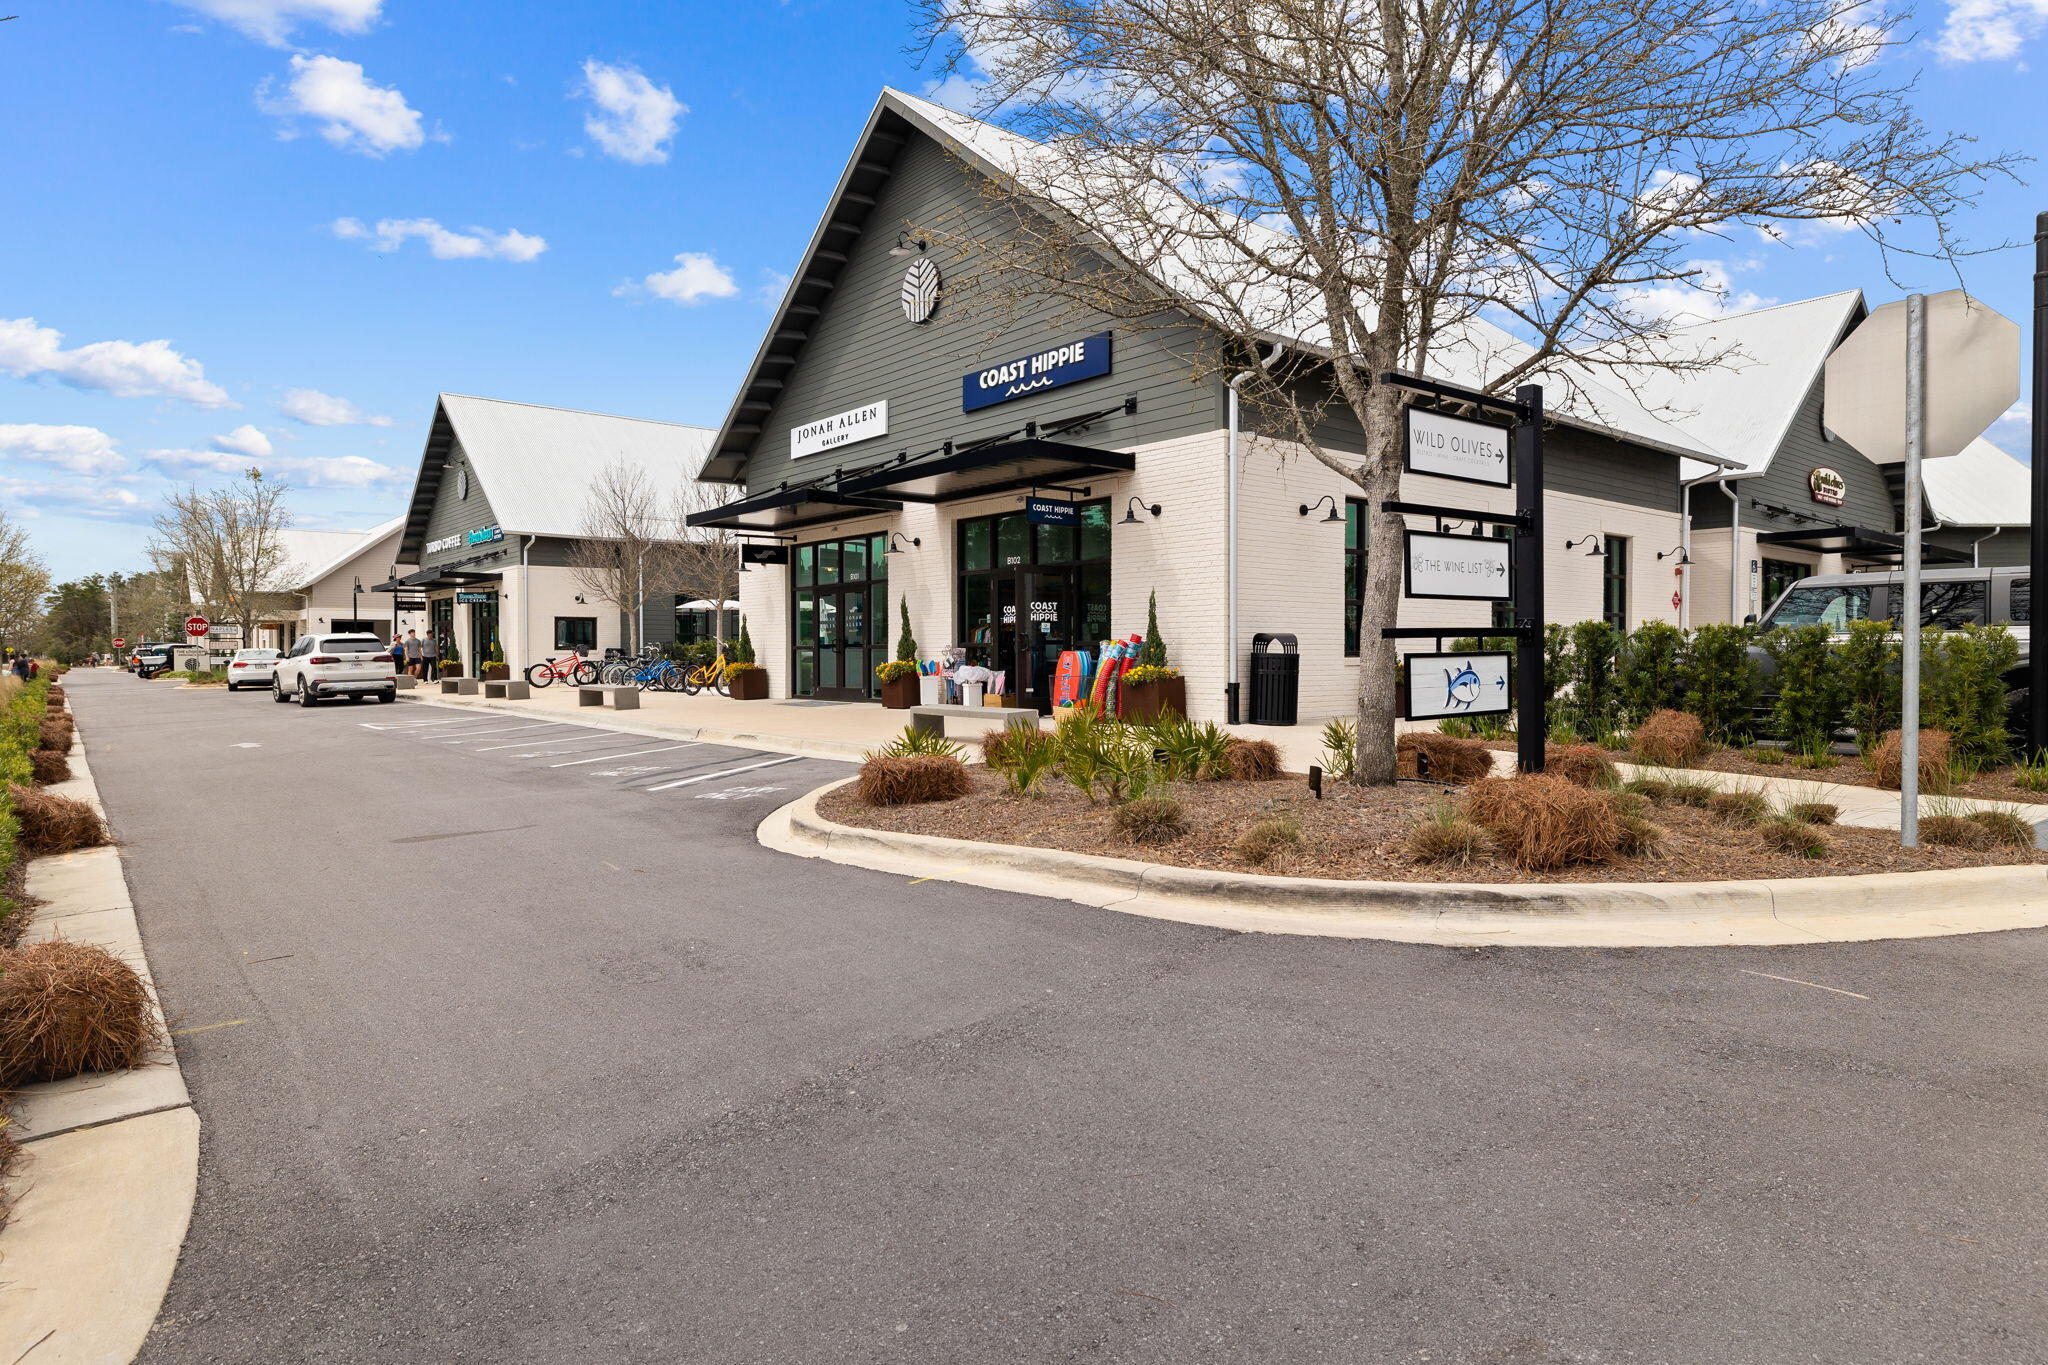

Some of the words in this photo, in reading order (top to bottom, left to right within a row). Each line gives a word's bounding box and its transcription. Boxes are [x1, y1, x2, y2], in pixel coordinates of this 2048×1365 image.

[979, 359, 1028, 389] COAST
[1031, 341, 1085, 375] HIPPIE
[798, 420, 833, 444] JONAH
[839, 407, 877, 429] ALLEN
[821, 433, 849, 447] GALLERY
[1413, 428, 1445, 449] WILD
[1450, 436, 1492, 459] OLIVES
[1032, 503, 1053, 512] COAST
[1054, 505, 1074, 515] HIPPIE
[442, 534, 461, 550] COFFEE
[1007, 556, 1021, 565] B102
[1424, 559, 1441, 572] THE
[1443, 560, 1465, 573] WINE
[1467, 561, 1483, 574] LIST
[1003, 605, 1016, 613] COA
[1030, 601, 1058, 611] COAST
[1030, 613, 1058, 622] HIPPIE
[187, 623, 208, 632] STOP
